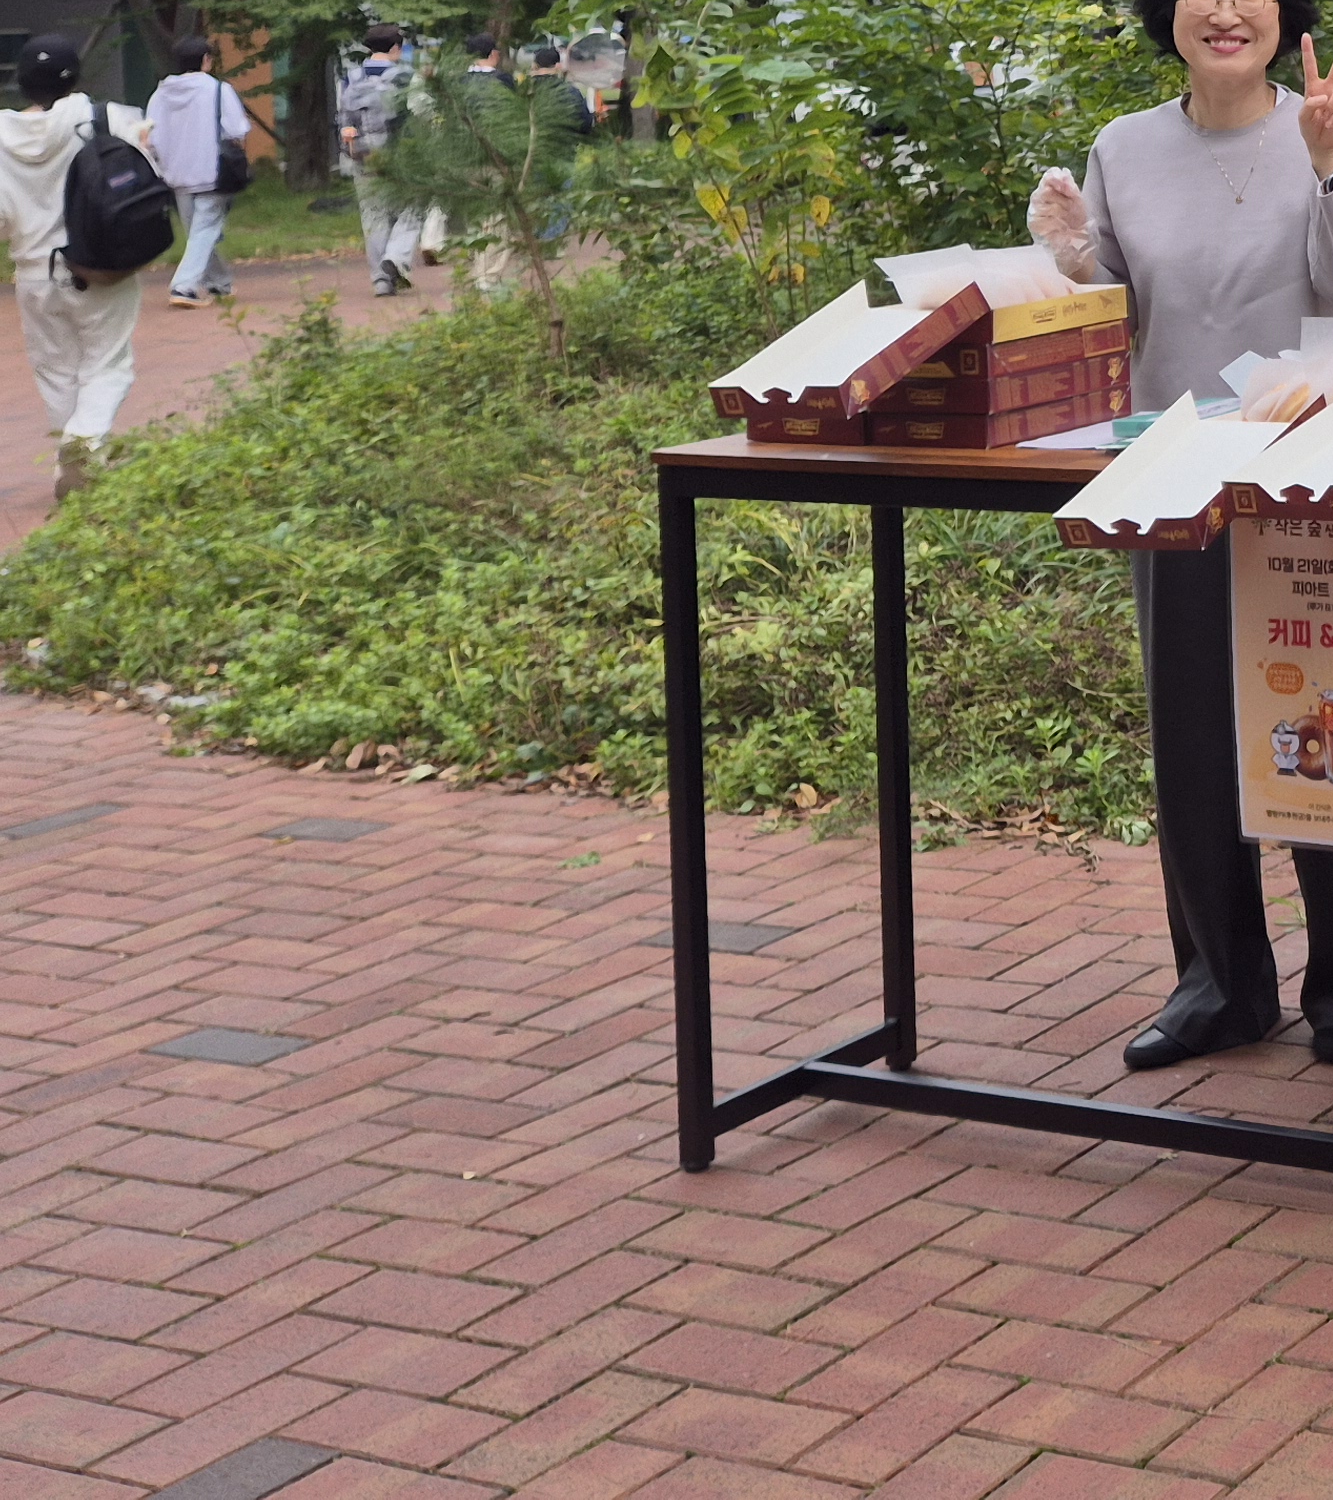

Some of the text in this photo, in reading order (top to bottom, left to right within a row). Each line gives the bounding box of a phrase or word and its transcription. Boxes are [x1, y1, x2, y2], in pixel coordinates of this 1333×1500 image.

[1268, 556, 1294, 573] 10월
[1292, 580, 1330, 597] 피아트
[1268, 618, 1312, 649] 커피
